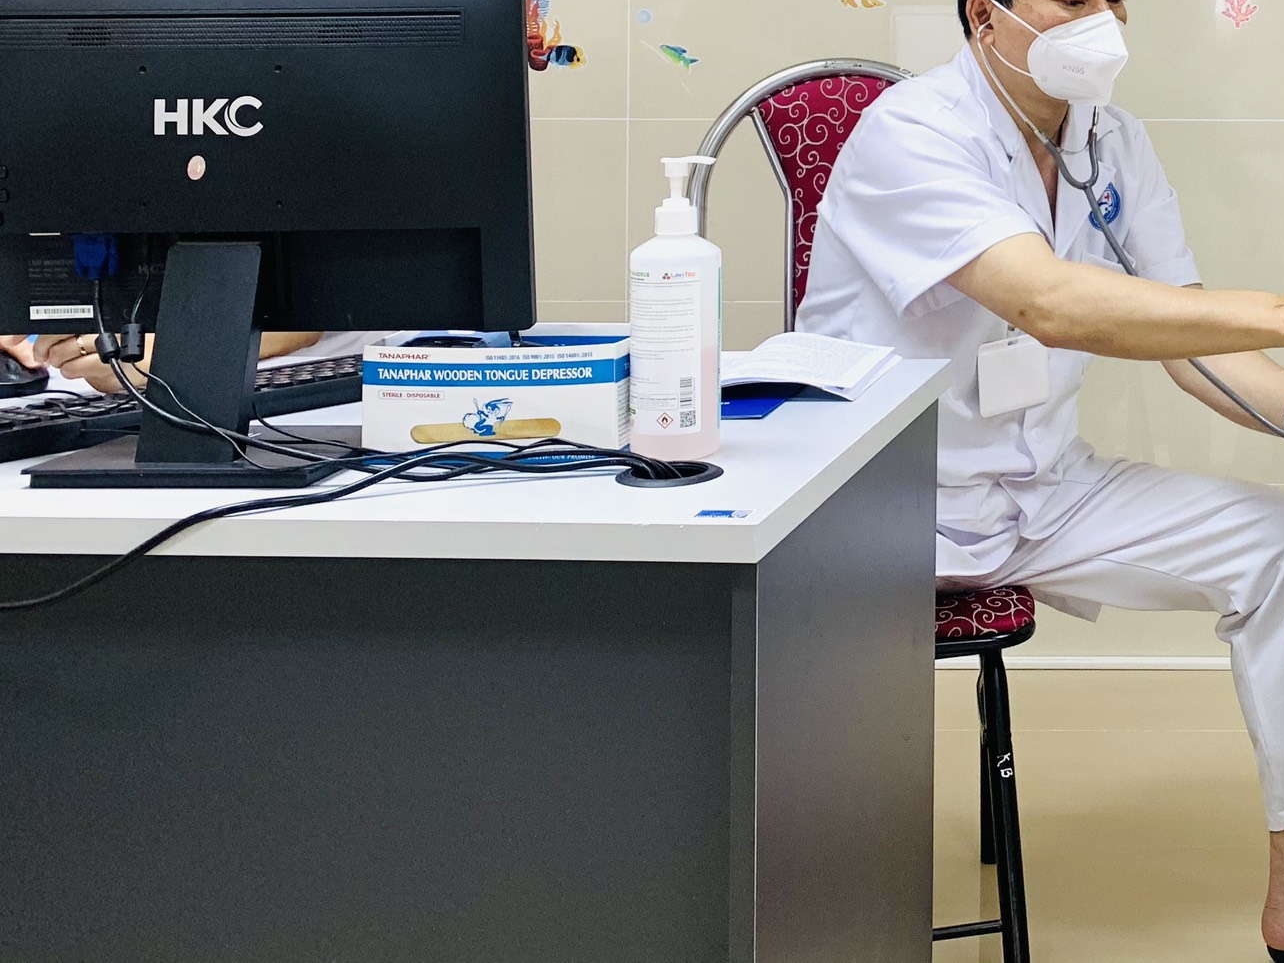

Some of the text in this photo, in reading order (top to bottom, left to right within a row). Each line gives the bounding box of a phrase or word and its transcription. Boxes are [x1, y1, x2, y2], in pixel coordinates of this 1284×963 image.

[1062, 64, 1085, 76] KN95
[154, 95, 264, 137] HKC
[378, 367, 593, 381] TANAPHAR WOODEN TONGUE DEPRESSOR
